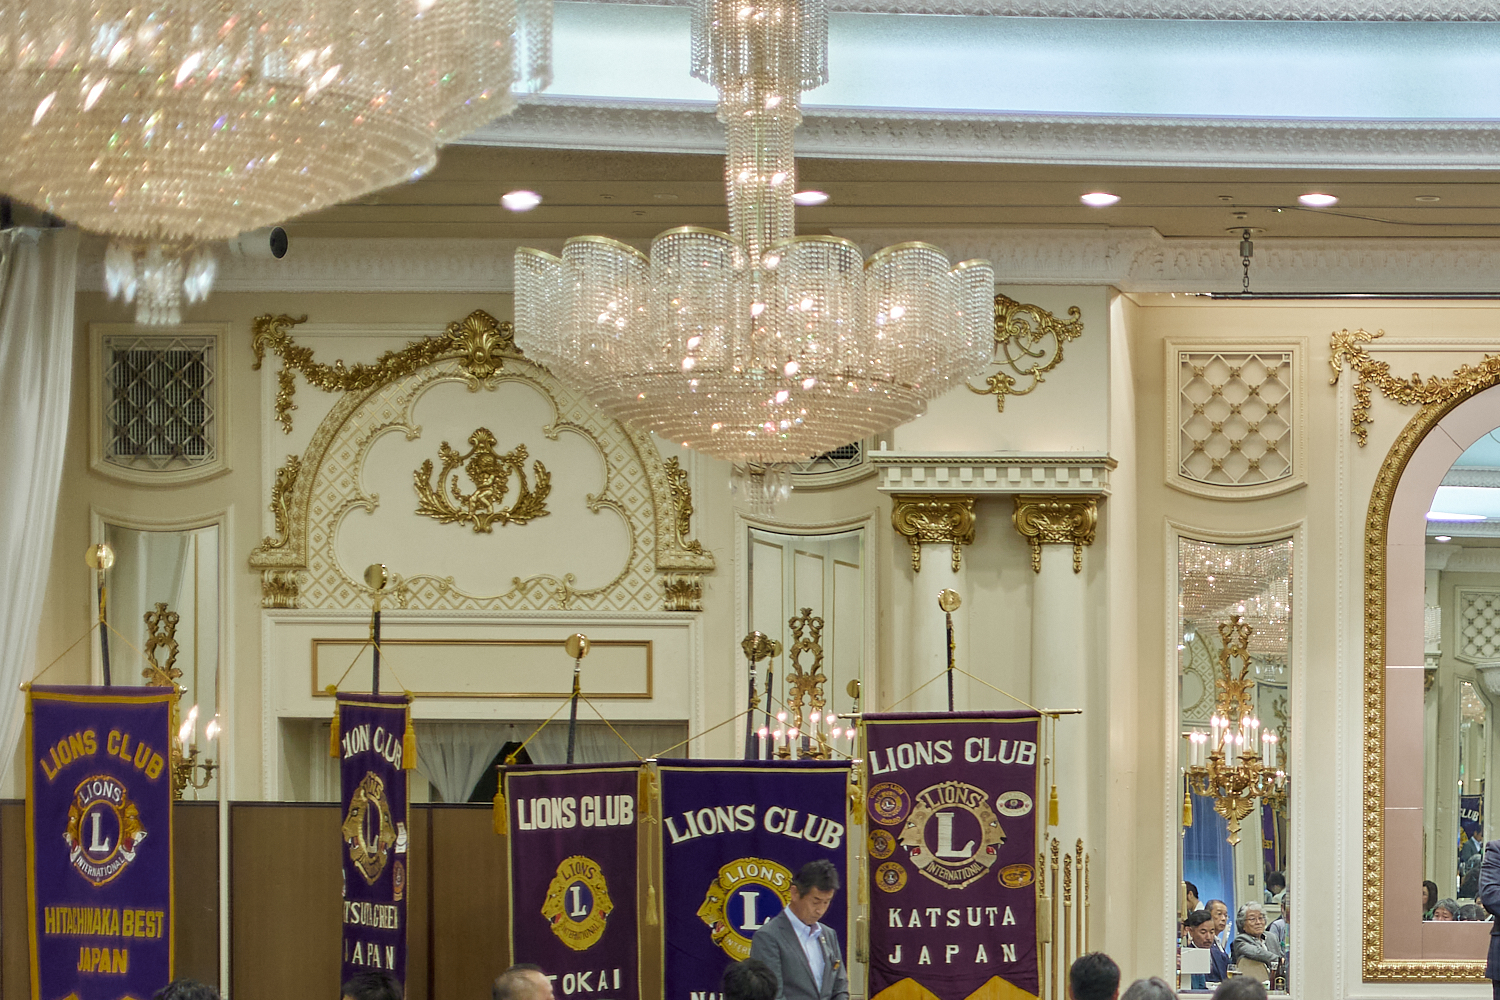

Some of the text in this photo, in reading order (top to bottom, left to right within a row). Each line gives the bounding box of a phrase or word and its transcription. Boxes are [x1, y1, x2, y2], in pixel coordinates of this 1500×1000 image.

[40, 730, 164, 780] LIONS CLUB
[869, 737, 1037, 775] LIONS CLUB
[79, 781, 122, 804] LIONS
[924, 787, 982, 809] LIONS
[517, 795, 634, 830] LIONS CLUB
[664, 804, 845, 849] LIONS CLUB
[89, 813, 109, 852] L
[935, 812, 976, 858] L
[76, 856, 126, 877] INTERNATIONAL
[562, 862, 597, 880] LIONS
[725, 864, 786, 886] LIONS
[926, 862, 984, 881] INTERNATIONAL
[570, 886, 587, 917] L
[738, 891, 771, 930] L
[45, 907, 164, 938] HITACHINAKA BEST
[888, 905, 1016, 928] KATSUTA
[77, 947, 128, 973] JAPAN
[888, 944, 1017, 965] JAPAN
